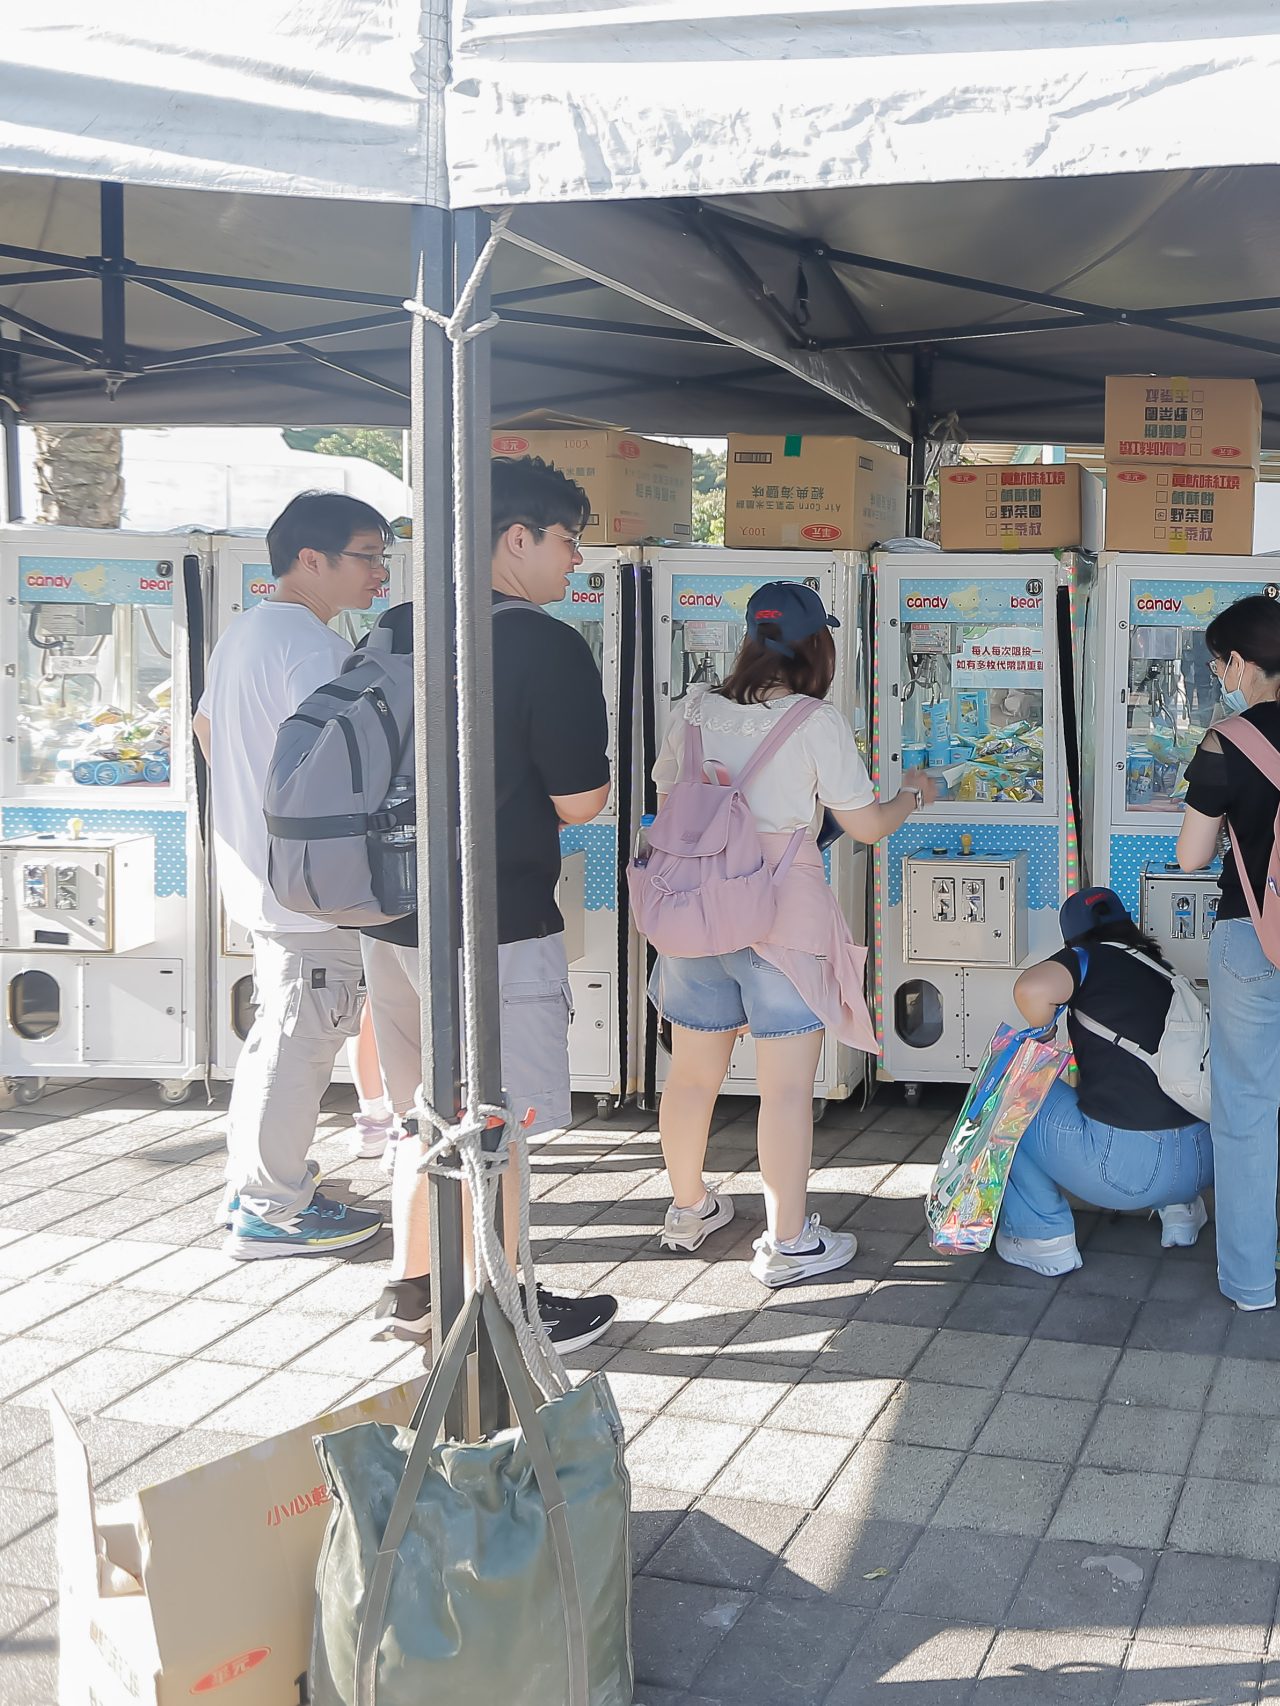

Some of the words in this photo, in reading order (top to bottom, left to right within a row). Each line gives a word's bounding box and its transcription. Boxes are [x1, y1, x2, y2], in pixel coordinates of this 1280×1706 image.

[752, 485, 824, 500] 經典海鹽味
[799, 503, 821, 512] Corn
[825, 503, 841, 512] Air
[1000, 505, 1042, 518] 野菜園
[1170, 508, 1214, 523] 野菜園
[160, 565, 167, 575] 7
[27, 575, 72, 589] candy
[140, 578, 173, 590] bear
[590, 577, 601, 587] 19
[1029, 582, 1039, 593] 13
[251, 583, 276, 594] can
[1267, 586, 1276, 598] 9
[571, 590, 604, 603] bear
[679, 594, 722, 608] candy
[907, 596, 948, 610] candy
[1010, 596, 1043, 608] bear
[1137, 598, 1182, 612] candy
[972, 645, 1044, 656] 每人每次限投一
